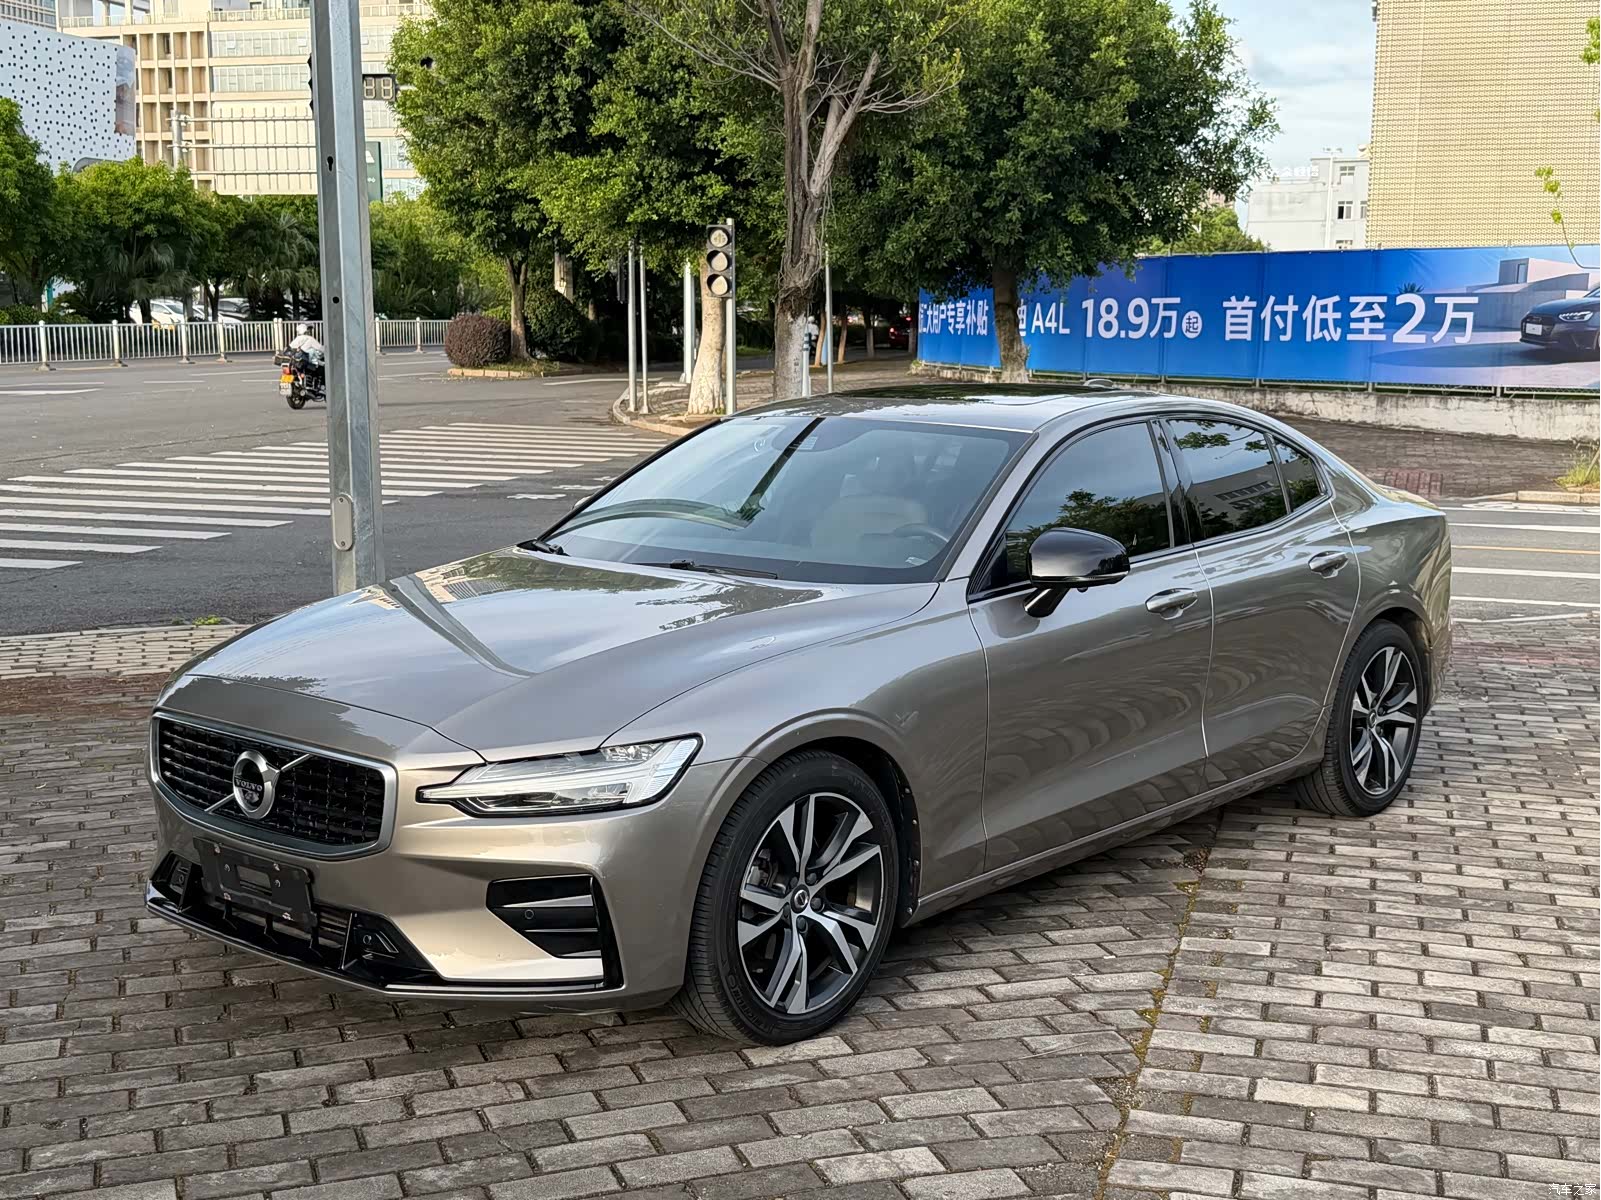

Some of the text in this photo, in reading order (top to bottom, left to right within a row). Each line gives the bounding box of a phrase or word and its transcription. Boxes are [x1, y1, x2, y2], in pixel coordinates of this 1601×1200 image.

[1031, 302, 1070, 334] A4L
[1222, 294, 1479, 344] 首付低至2万
[235, 778, 263, 792] VOLVO
